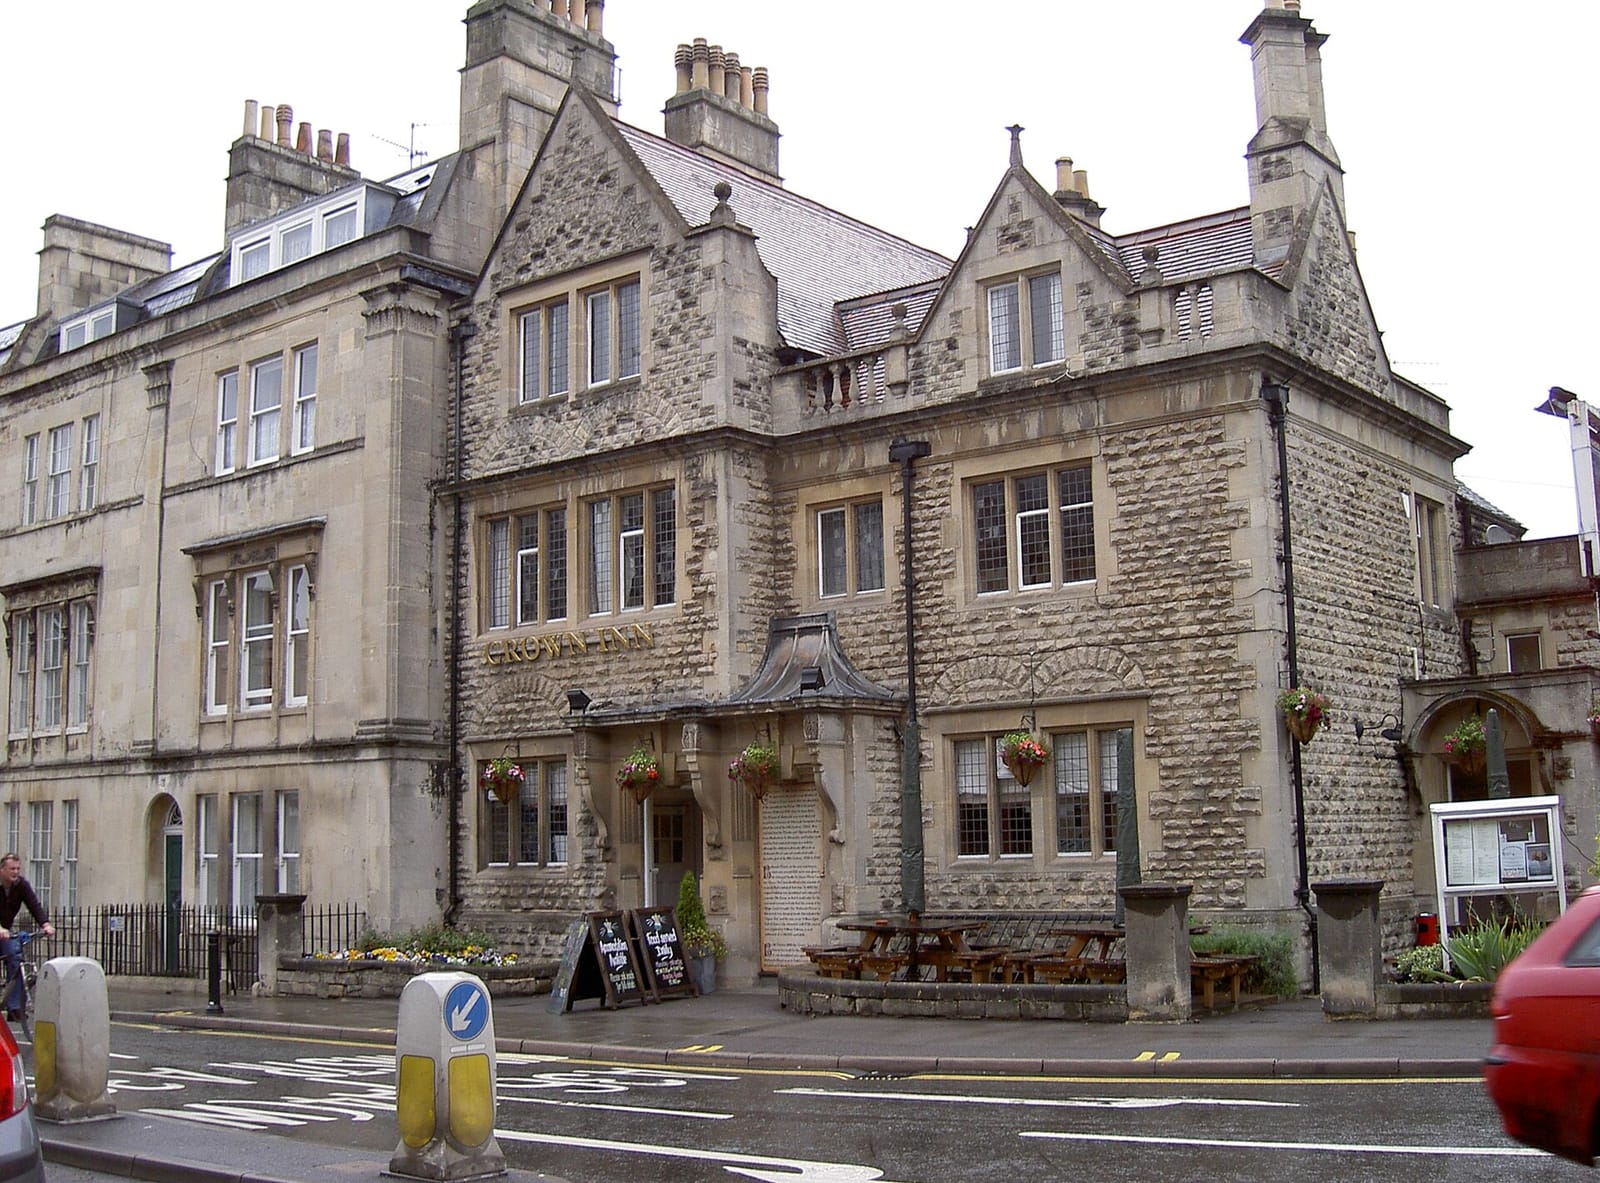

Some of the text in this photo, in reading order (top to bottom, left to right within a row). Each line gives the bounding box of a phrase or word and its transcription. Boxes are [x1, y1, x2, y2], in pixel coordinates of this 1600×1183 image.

[482, 622, 654, 665] CROWN INN
[646, 931, 660, 945] Food
